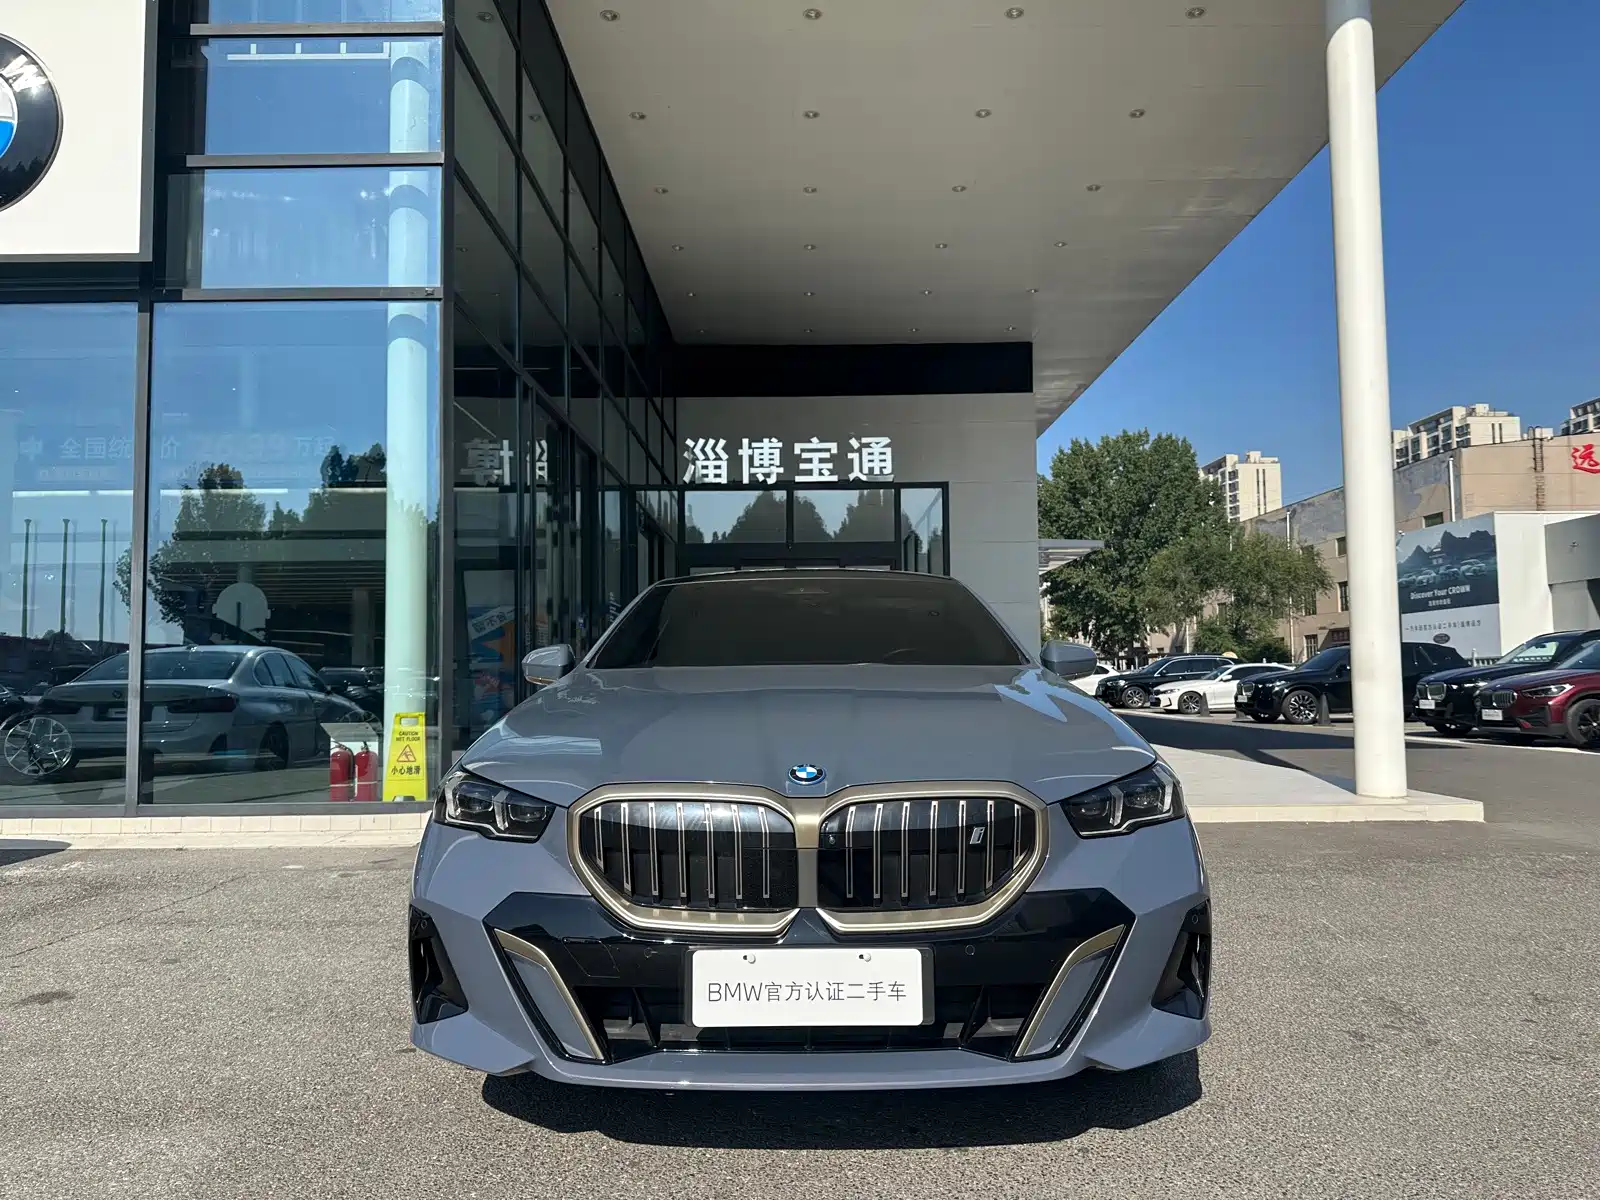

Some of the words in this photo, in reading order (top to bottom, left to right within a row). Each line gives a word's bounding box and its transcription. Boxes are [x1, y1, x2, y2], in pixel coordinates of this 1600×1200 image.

[682, 436, 895, 485] 淄博宝通
[1410, 591, 1433, 600] Discover
[1448, 584, 1471, 595] CROWN
[391, 765, 421, 776] 小心地滑
[707, 981, 907, 1002] BMW官方认证二手车
